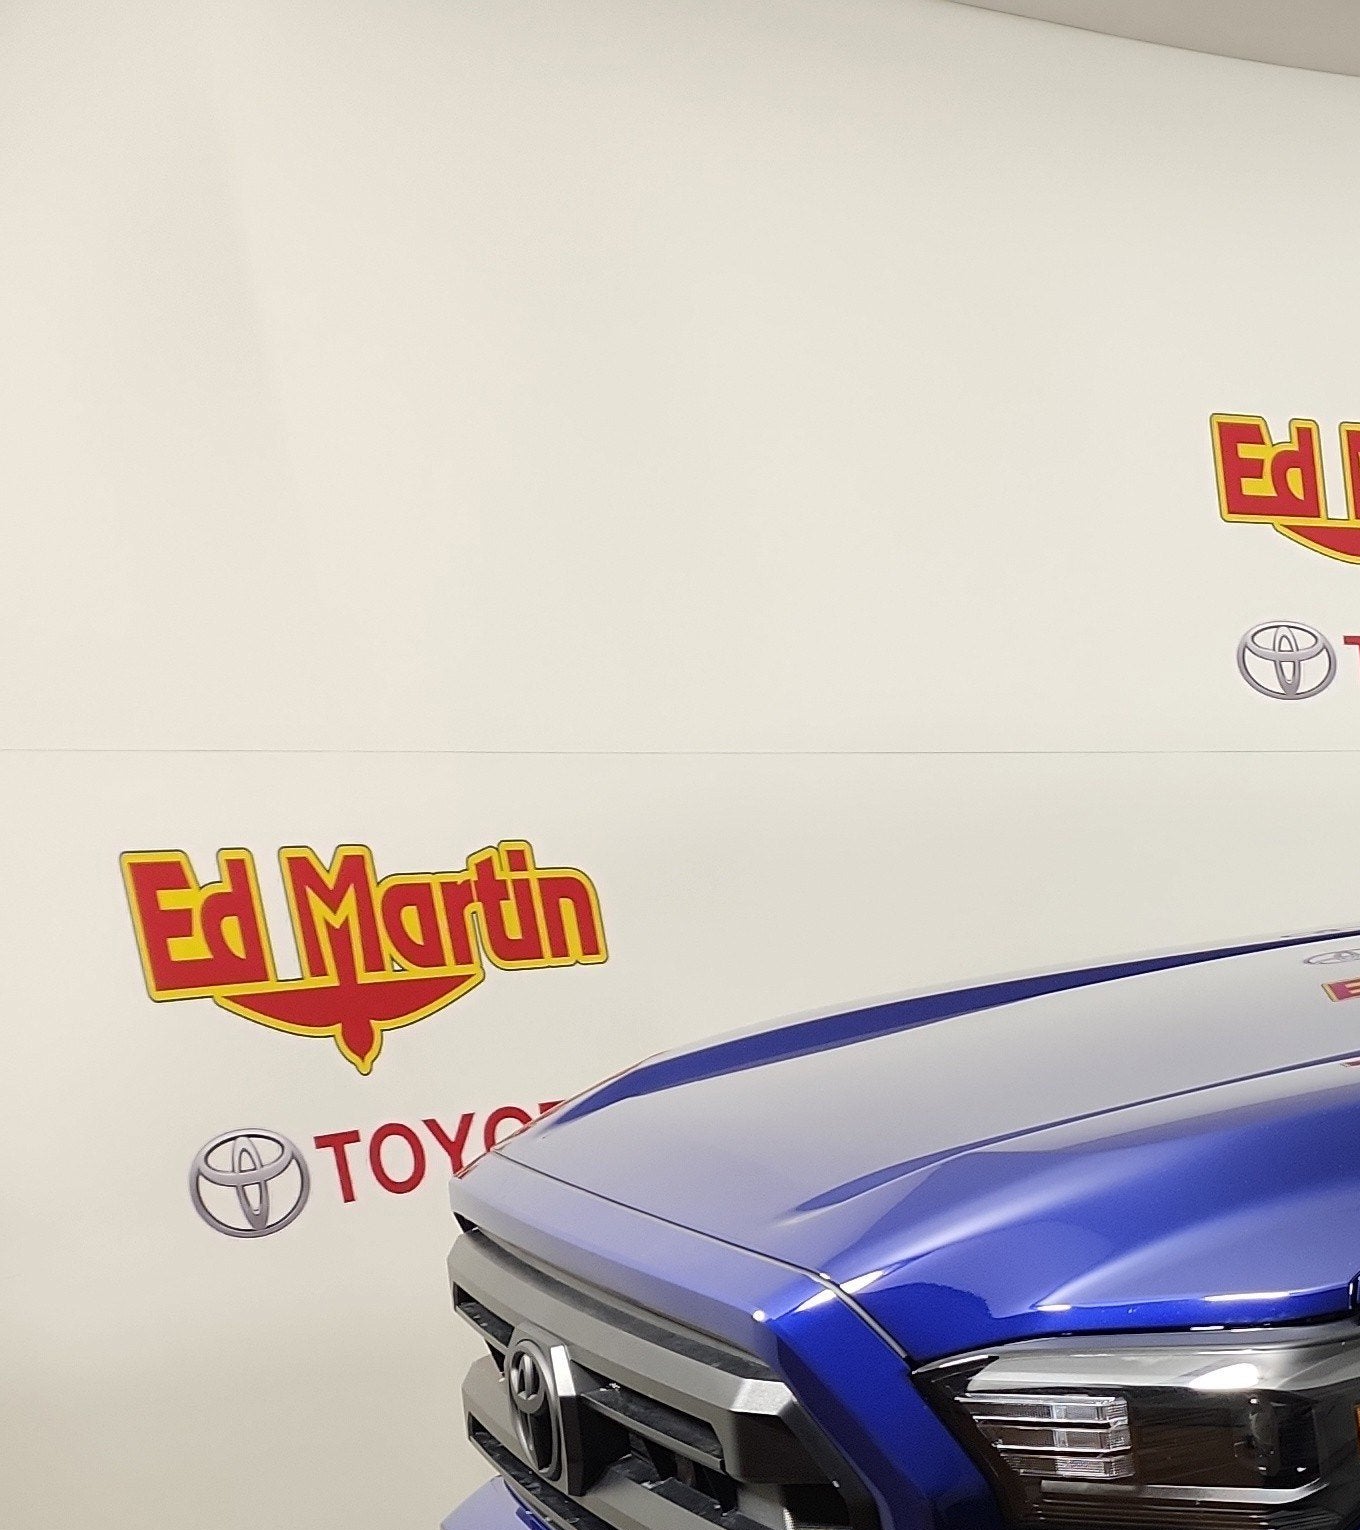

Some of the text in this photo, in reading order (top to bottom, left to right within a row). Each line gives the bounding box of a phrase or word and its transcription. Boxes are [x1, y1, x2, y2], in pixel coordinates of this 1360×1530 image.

[1211, 413, 1327, 523] Ed
[119, 840, 608, 1001] Ed Martin
